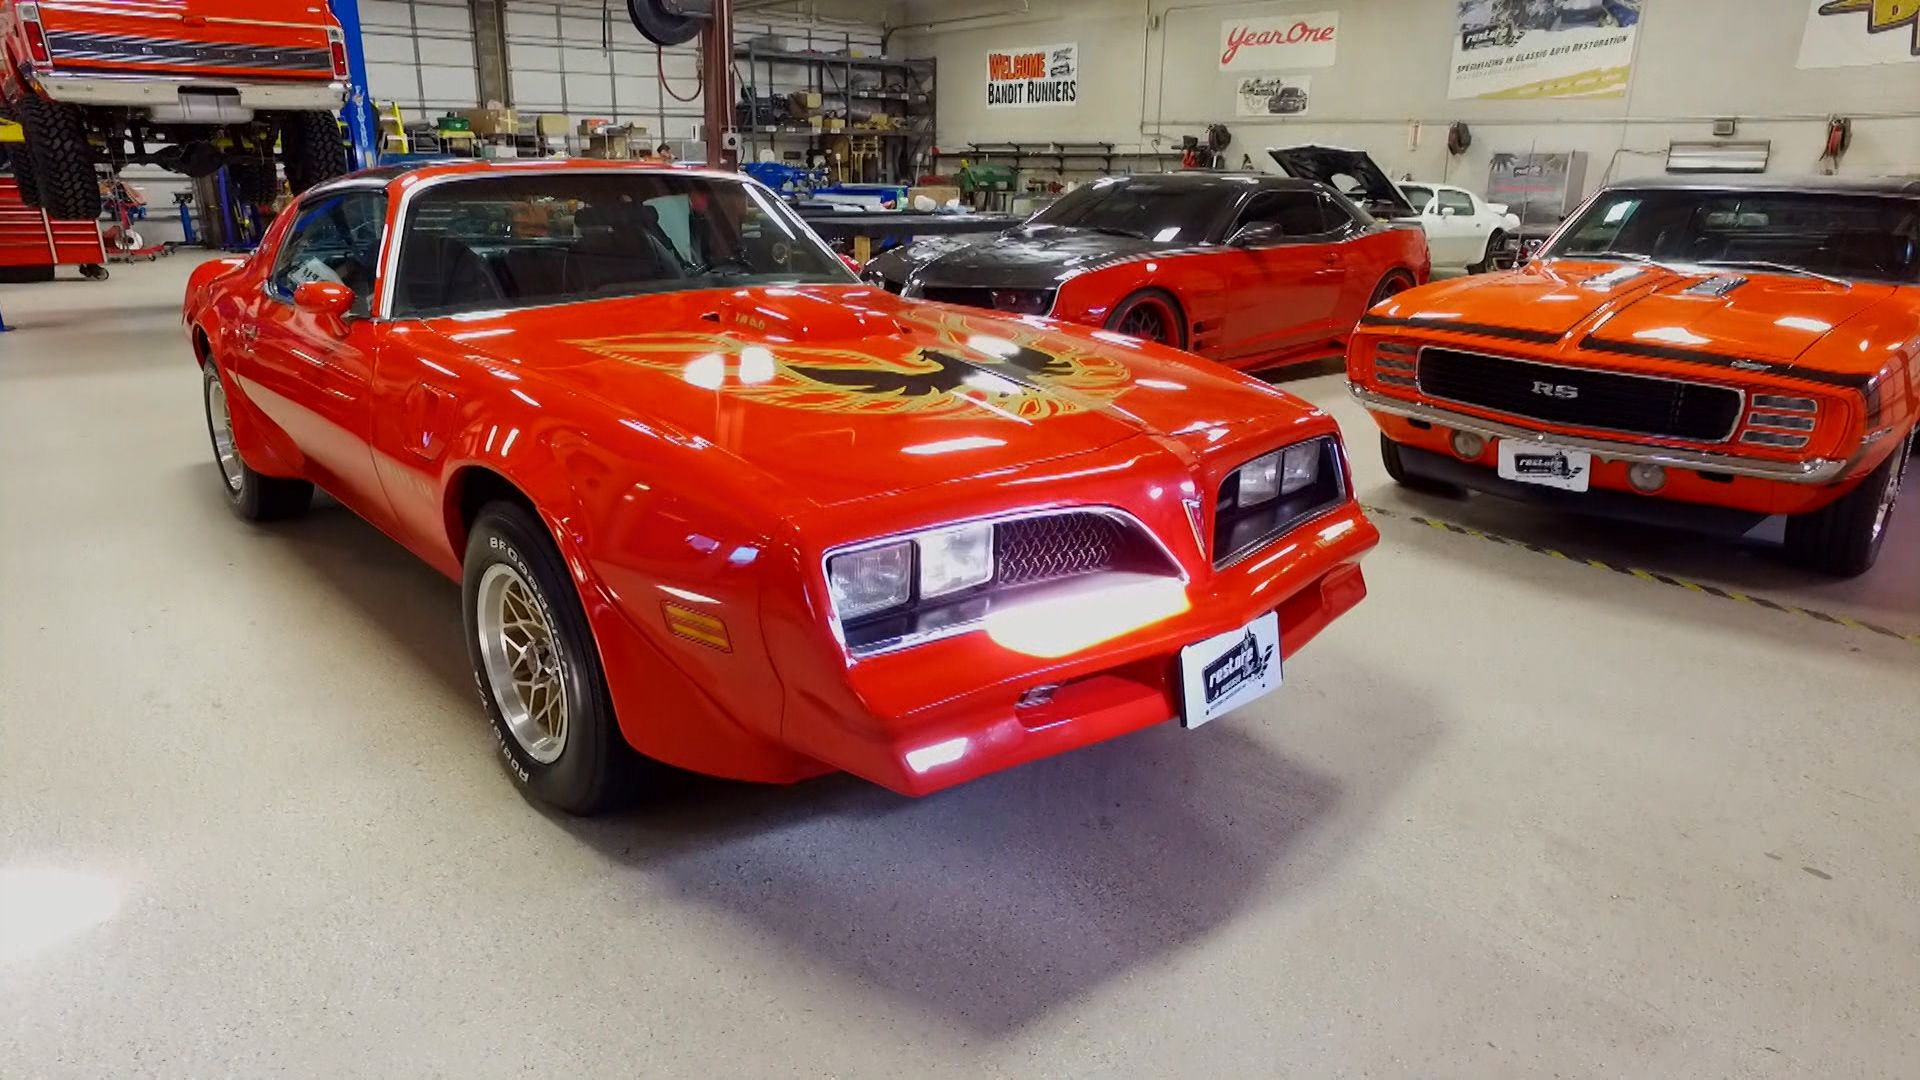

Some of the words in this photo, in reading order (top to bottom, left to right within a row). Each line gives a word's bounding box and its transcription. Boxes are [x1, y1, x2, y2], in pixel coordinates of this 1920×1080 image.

[1505, 55, 1515, 64] IN
[1515, 50, 1549, 62] CLASSIC
[1549, 45, 1571, 56] AUTO
[1572, 35, 1628, 52] RESTORATION
[988, 51, 1047, 81] WELCOME
[988, 82, 1024, 104] BANDIT
[1027, 80, 1077, 103] RUNNERS
[1531, 381, 1579, 399] RS
[1208, 646, 1254, 689] restore
